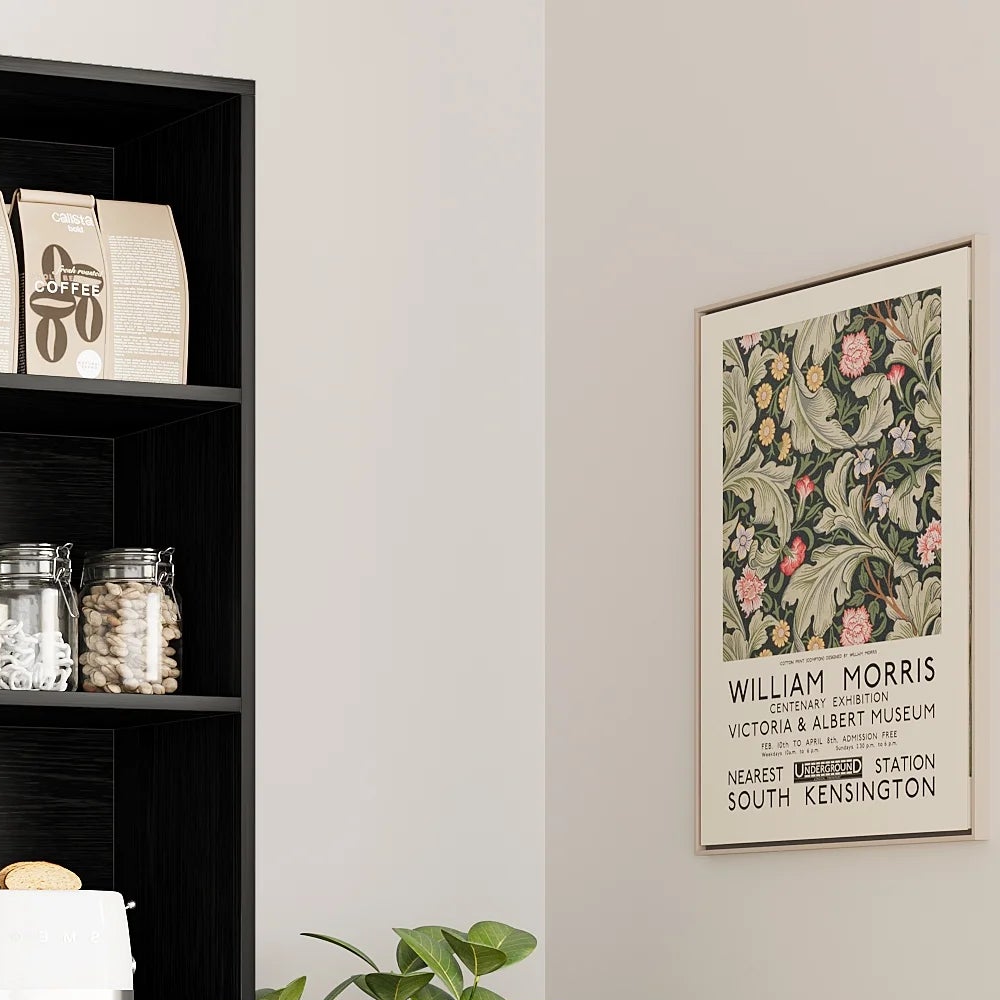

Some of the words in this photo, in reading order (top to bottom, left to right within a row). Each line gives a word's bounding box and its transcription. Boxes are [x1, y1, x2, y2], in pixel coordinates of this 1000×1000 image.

[34, 280, 100, 297] COFFEE
[728, 669, 825, 704] WILLIAM
[843, 656, 936, 692] MORRIS
[769, 698, 826, 714] CENTENARY
[832, 691, 889, 708] EXHIBITION
[728, 719, 792, 739] VICTORIA
[797, 718, 806, 732] &
[812, 710, 865, 730] ALBERT
[871, 703, 936, 725] MUSEUM
[793, 739, 802, 747] TO
[805, 738, 823, 746] APRIL
[842, 732, 878, 743] ADMISSION
[881, 730, 898, 739] FREE
[728, 766, 784, 786] NEAREST
[875, 753, 936, 774] STATION
[728, 787, 790, 811] SOUTH
[805, 776, 936, 806] KENSINGTON
